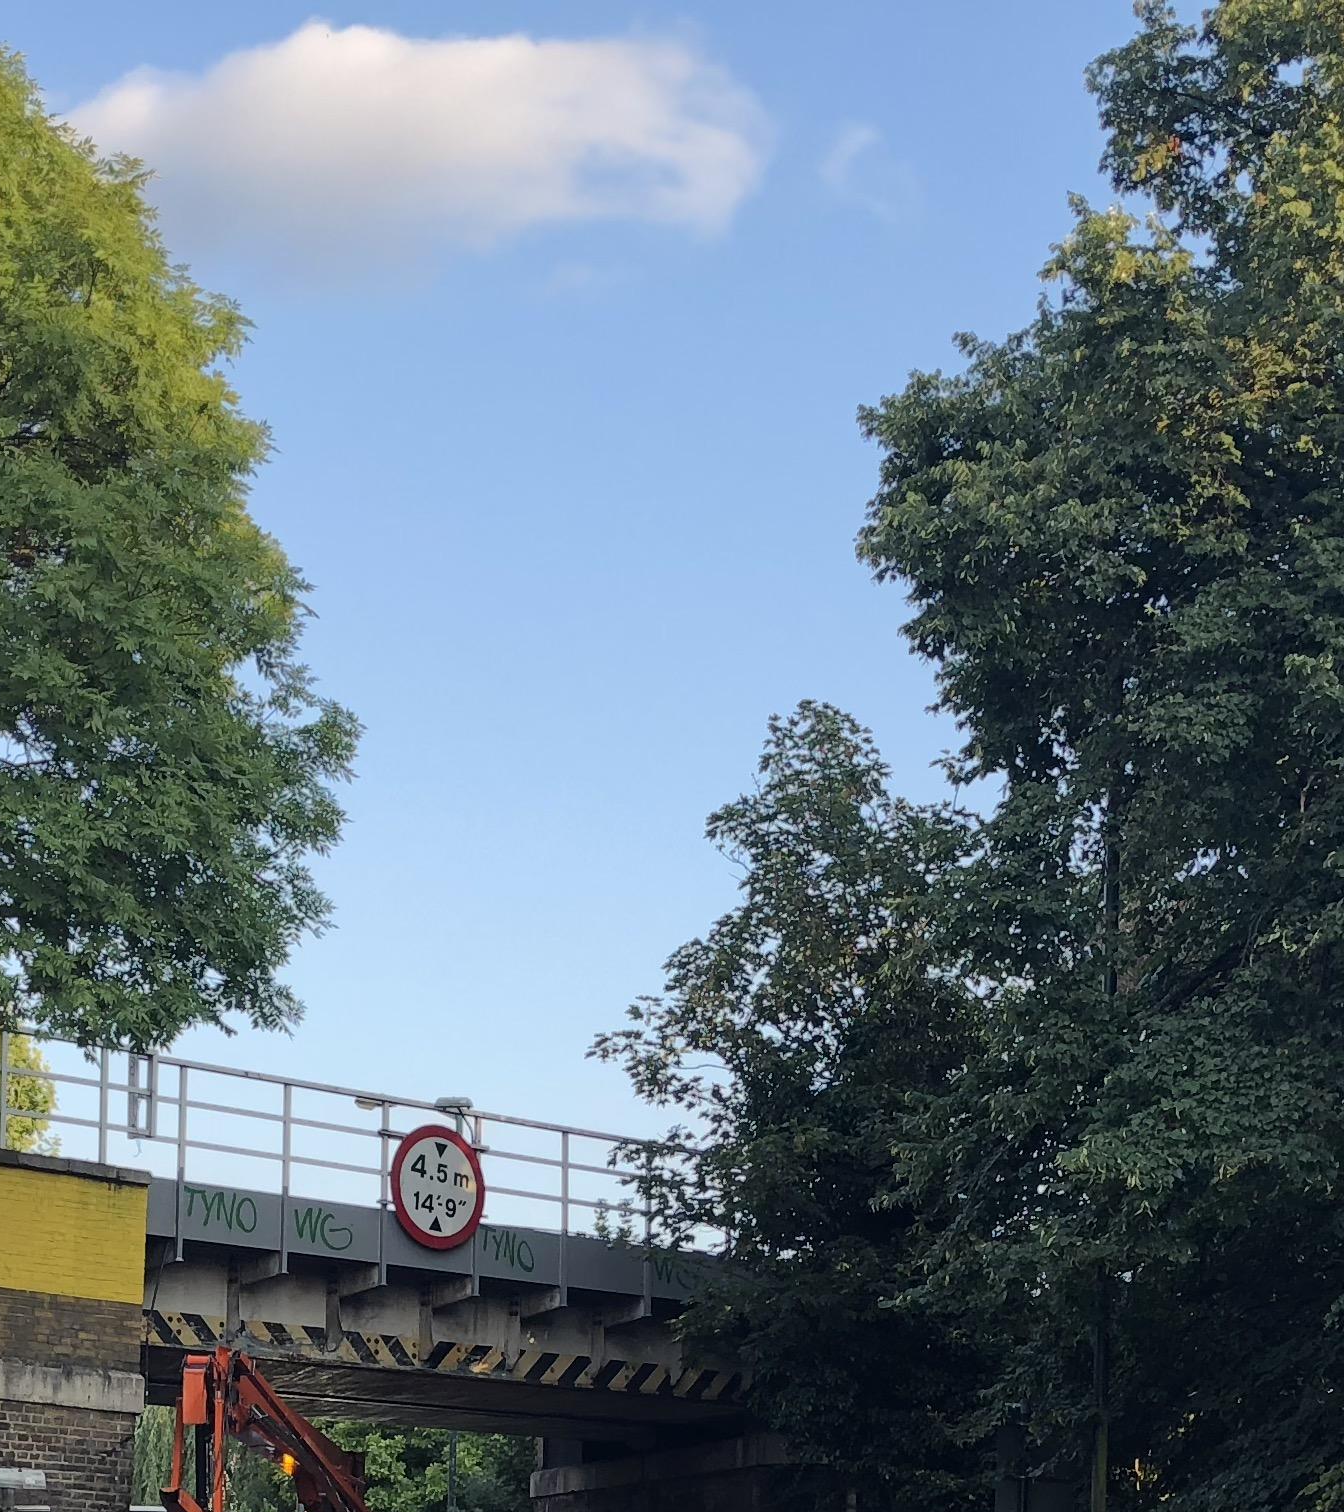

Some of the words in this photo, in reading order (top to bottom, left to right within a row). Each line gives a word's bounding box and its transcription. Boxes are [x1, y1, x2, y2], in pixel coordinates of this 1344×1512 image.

[410, 1154, 448, 1183] 4.5
[453, 1172, 469, 1188] m
[183, 1185, 257, 1233] TYNO
[294, 1207, 353, 1250] WG
[478, 1223, 534, 1273] TYNO
